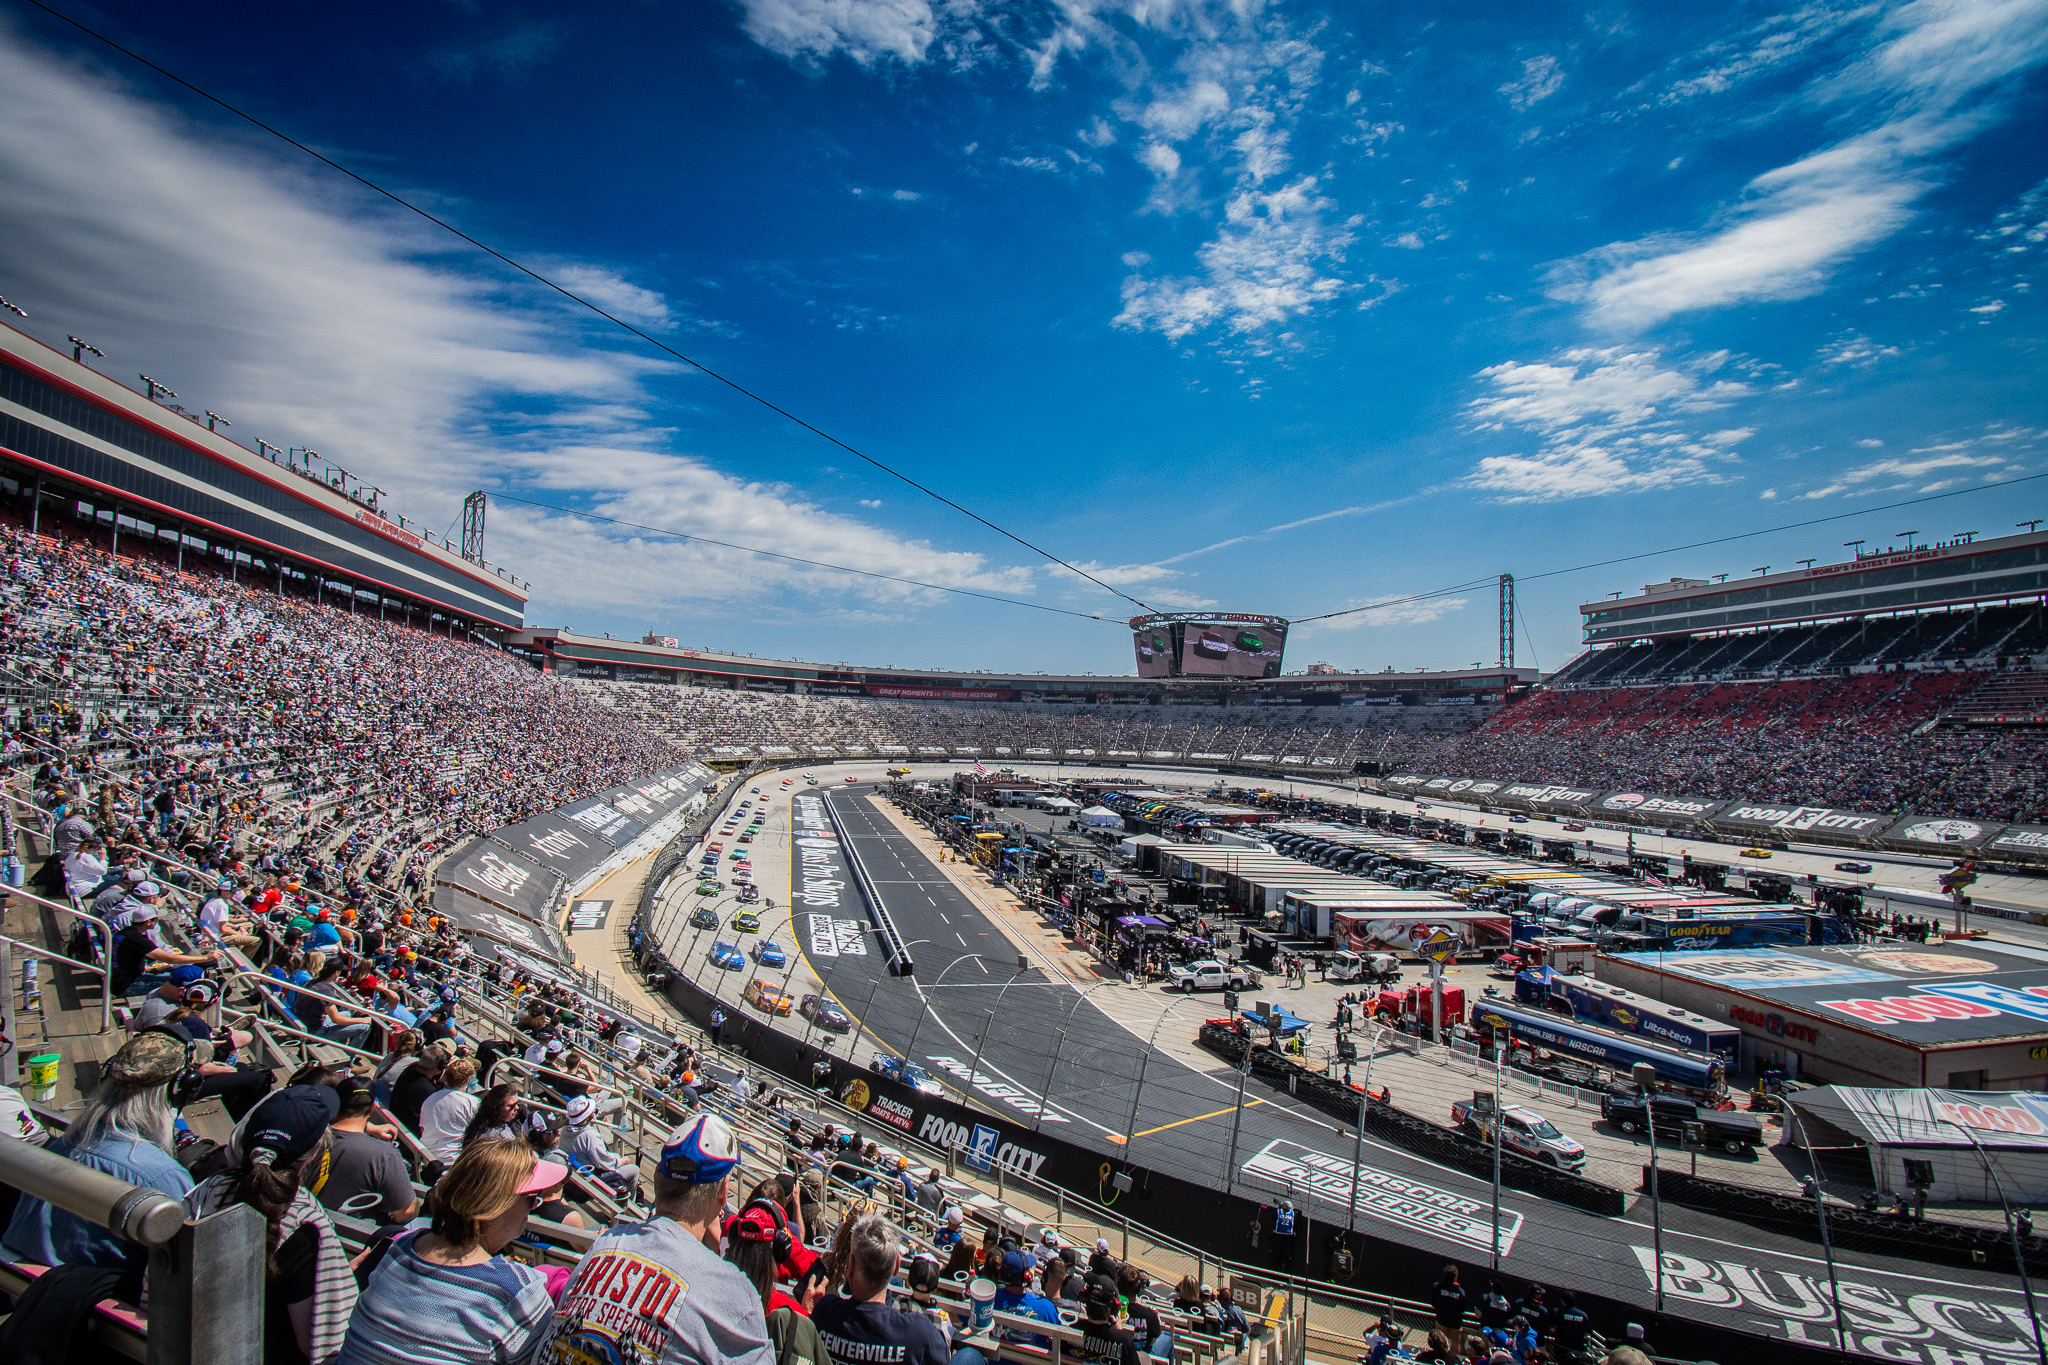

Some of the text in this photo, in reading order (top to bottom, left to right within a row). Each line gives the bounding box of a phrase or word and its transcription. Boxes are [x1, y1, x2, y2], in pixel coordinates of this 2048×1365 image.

[1812, 550, 1939, 576] WORLD'S FASTEST HALF-MILE
[880, 688, 901, 696] GREAT
[1505, 786, 1538, 797] FOOD
[1561, 791, 1592, 801] CITY
[1645, 797, 1714, 812] Bristol
[1594, 822, 1615, 830] MOTOR
[1615, 824, 1646, 833] SPEEDWAY
[1728, 807, 1878, 830] FOOD CITY
[528, 828, 589, 860] xfinity
[801, 847, 838, 864] Bass
[802, 865, 841, 879] Pro
[792, 878, 846, 908] Shops
[1975, 906, 2020, 919] FOOD CITY
[1421, 938, 1459, 957] SUNOCO
[1673, 937, 1720, 951] Racing
[1672, 959, 1833, 976] BUSH'S
[1610, 1009, 1638, 1024] SUNOCO
[1815, 994, 2002, 1025] FOOD
[1482, 1015, 1512, 1029] SUNOCO
[1729, 1005, 1819, 1046] FOOD CITY
[1517, 1024, 1606, 1057] OFFICIAL FUEL NASCAR
[871, 1105, 890, 1120] BOATS
[893, 1116, 910, 1129] ATVs
[876, 1095, 914, 1119] TRACKER
[1935, 1102, 2044, 1134] FOOD
[918, 1114, 1047, 1180] FOOD CITY
[1281, 1166, 1472, 1232] CUP SERIES
[1338, 1165, 1482, 1215] NASCAR
[567, 1255, 681, 1332] BRISTOL
[1233, 1287, 1258, 1306] BB
[596, 1301, 669, 1355] SPEEDWAY
[819, 1329, 906, 1363] CENTERVILLE
